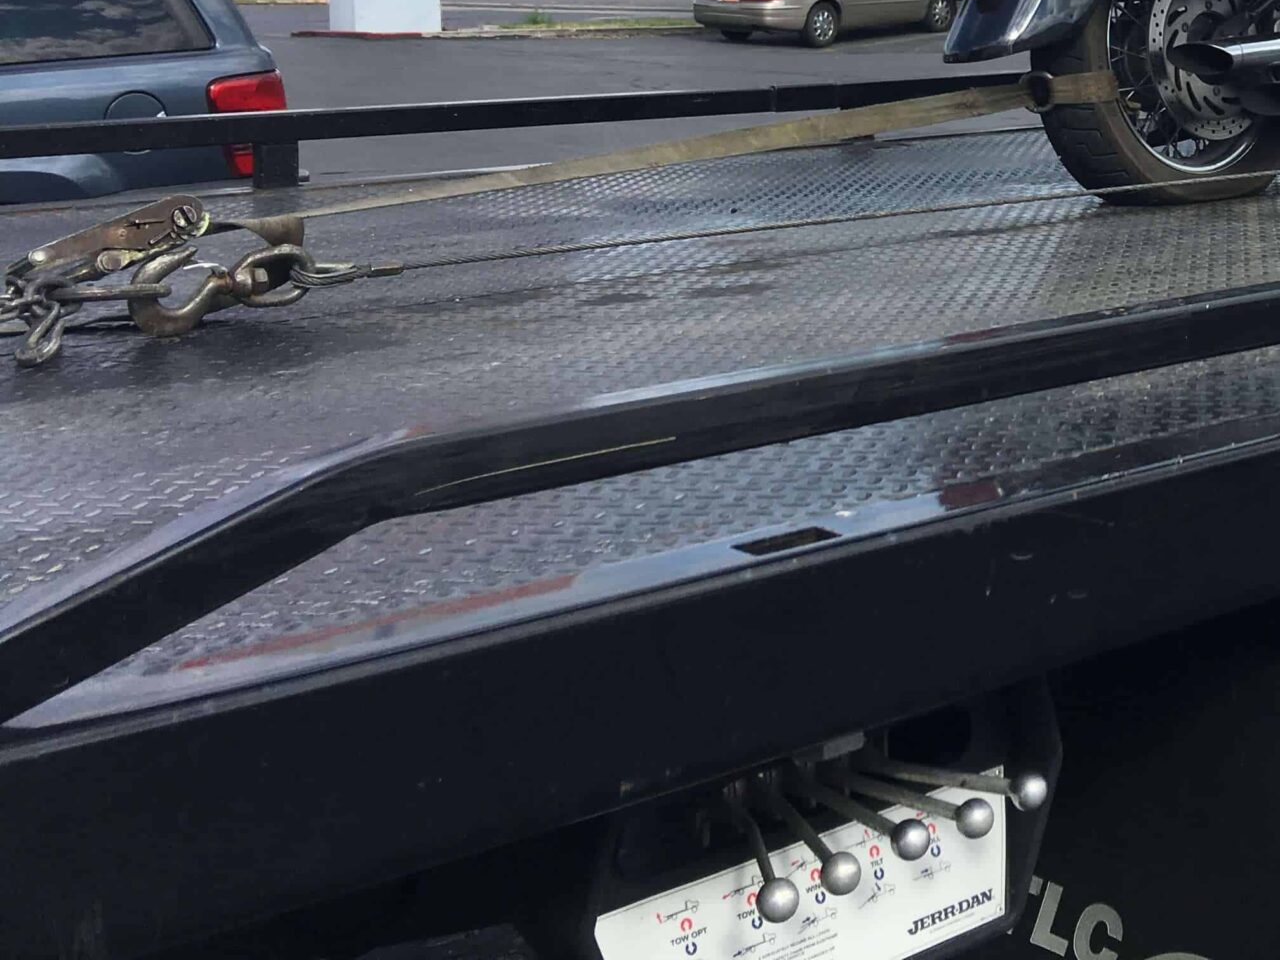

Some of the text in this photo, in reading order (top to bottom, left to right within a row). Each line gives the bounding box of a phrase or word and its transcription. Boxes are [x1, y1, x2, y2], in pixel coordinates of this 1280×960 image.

[870, 857, 884, 868] TILT
[736, 908, 756, 921] TOW
[670, 926, 708, 947] TOW OPT
